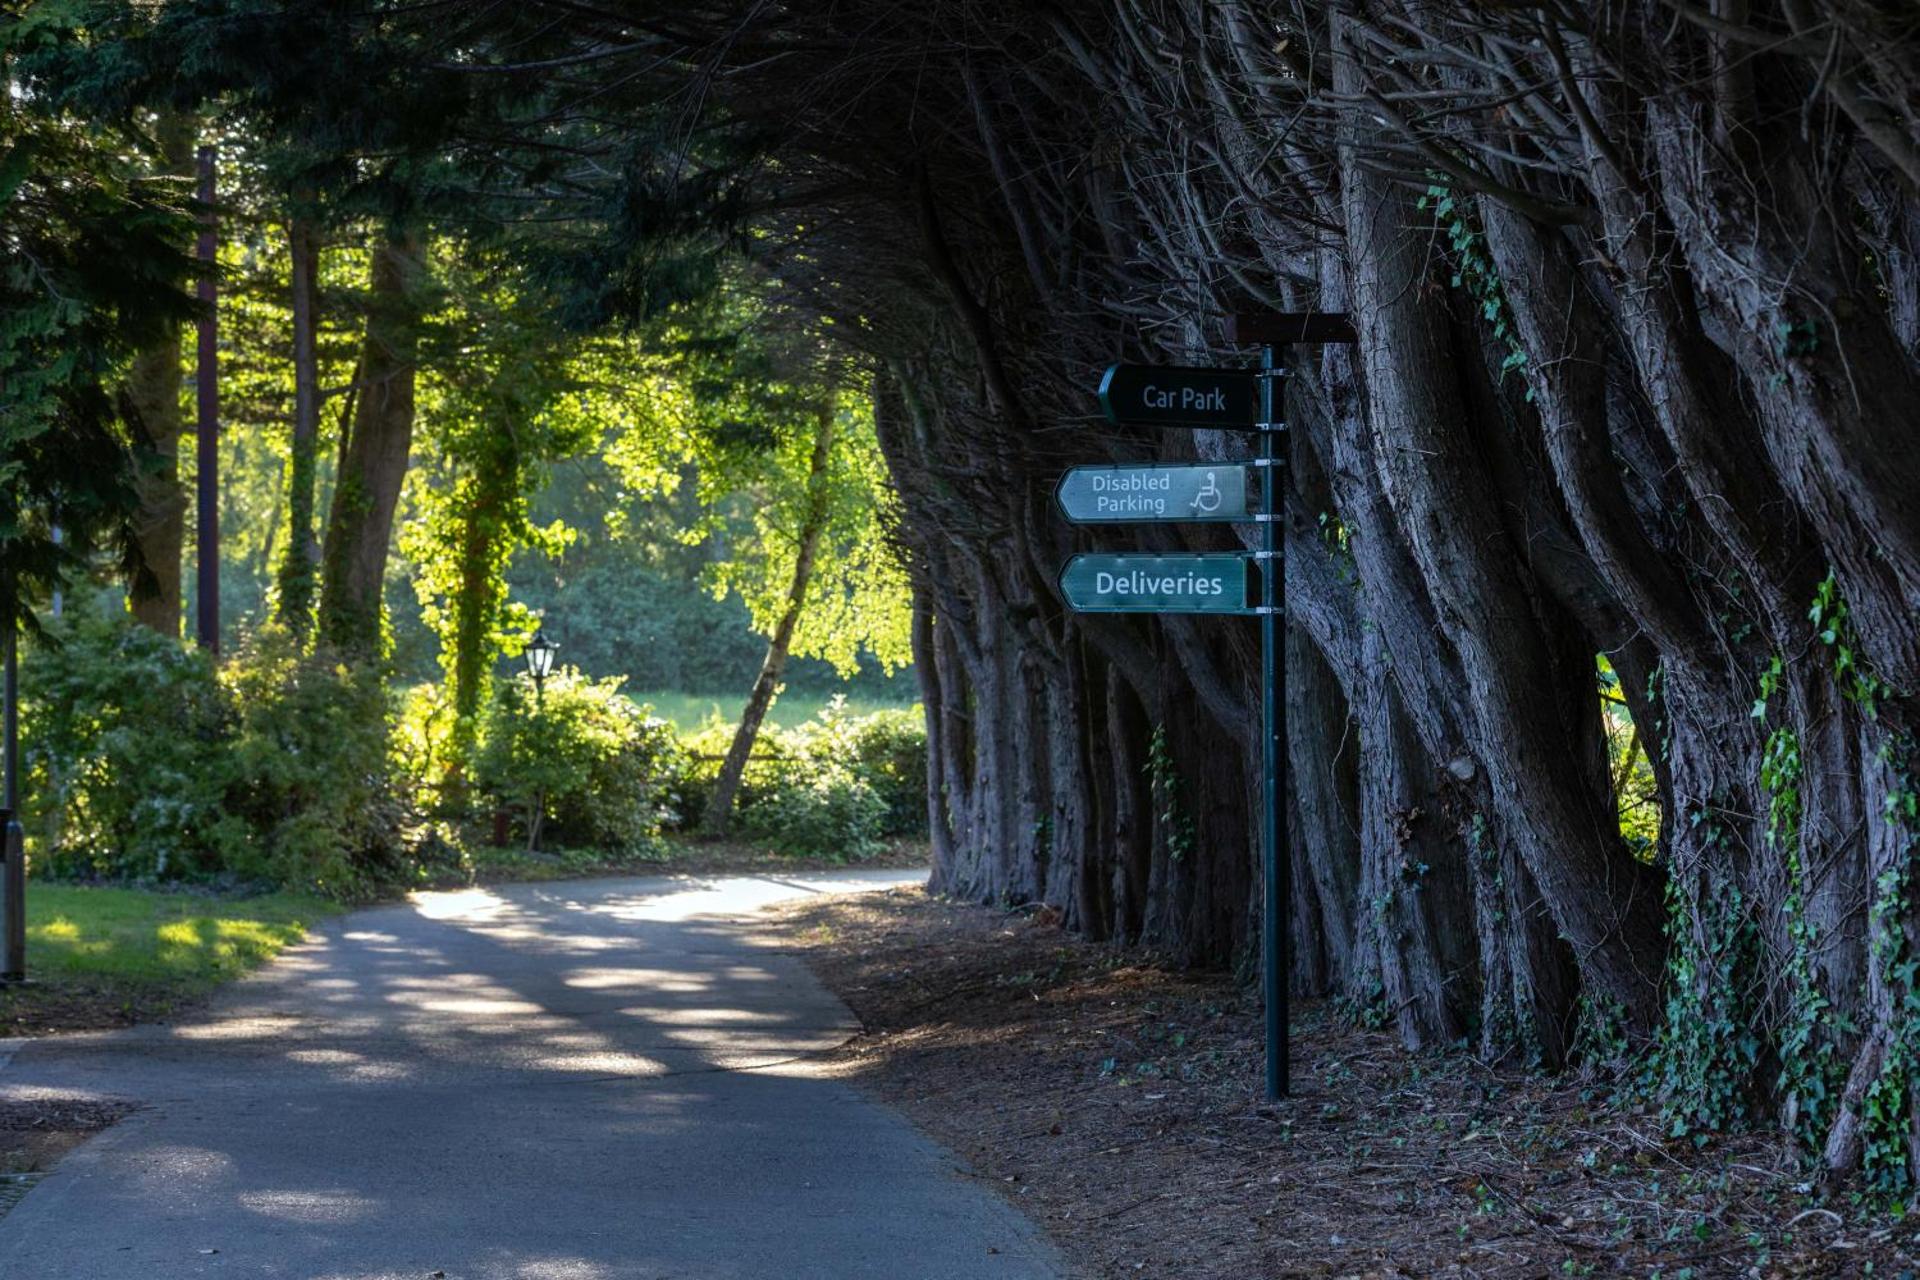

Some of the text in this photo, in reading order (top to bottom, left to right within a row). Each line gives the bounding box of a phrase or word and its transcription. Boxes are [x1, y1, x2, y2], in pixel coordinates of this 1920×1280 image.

[1143, 386, 1226, 411] Car Park
[1092, 473, 1170, 492] Disabled
[1097, 495, 1165, 514] Parking
[1096, 571, 1222, 595] Deliveries
